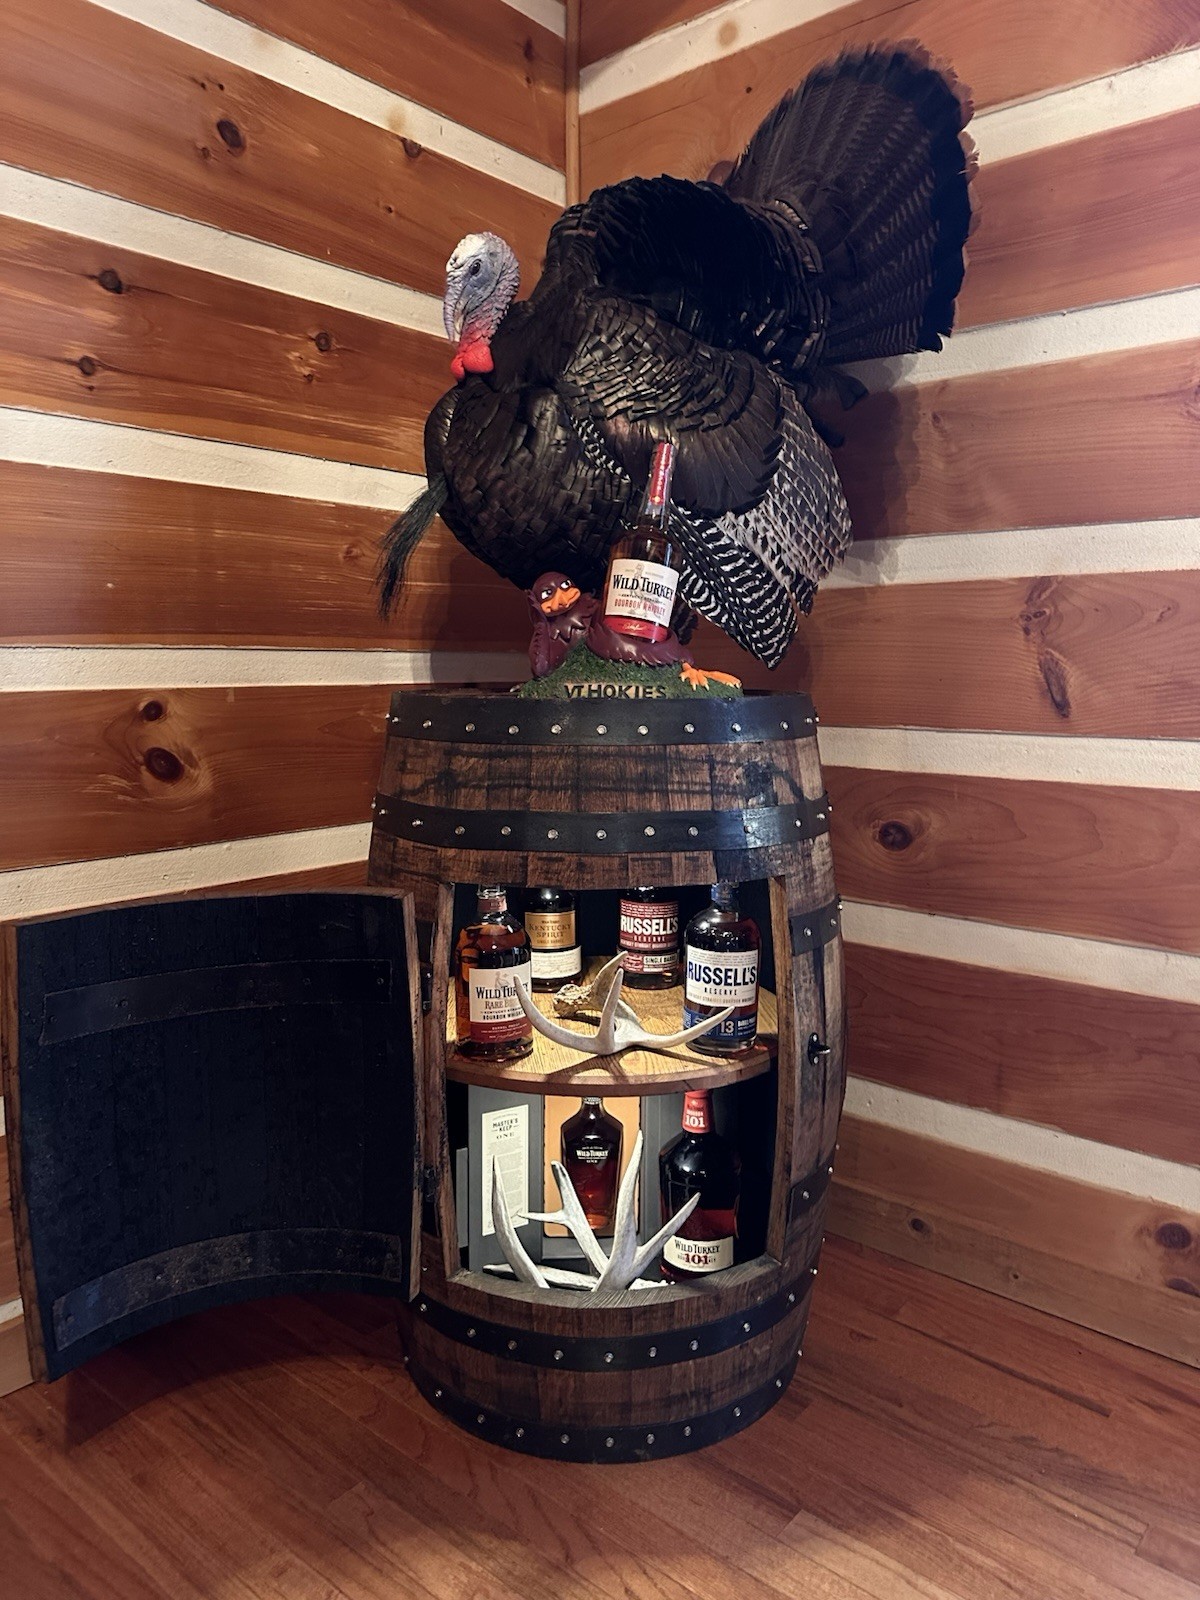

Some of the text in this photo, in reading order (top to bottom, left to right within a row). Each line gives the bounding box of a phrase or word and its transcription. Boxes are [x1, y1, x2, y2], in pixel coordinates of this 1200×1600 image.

[612, 575, 675, 601] WILD TURKEY
[614, 598, 641, 608] BOURBON
[564, 684, 667, 699] VT HOKIES
[529, 923, 571, 931] KENTUCKY
[620, 915, 679, 936] RUSSELL'S
[688, 960, 756, 987] RUSSELL'S
[475, 986, 501, 999] WILD
[704, 987, 737, 996] RESERVE
[485, 1000, 504, 1010] RARE
[720, 1020, 735, 1034] 13
[492, 1117, 519, 1128] MASTER'S
[685, 1114, 706, 1128] 101
[499, 1124, 513, 1132] KEEP
[675, 1239, 720, 1255] WILD TURKEY
[685, 1253, 709, 1265] 101
